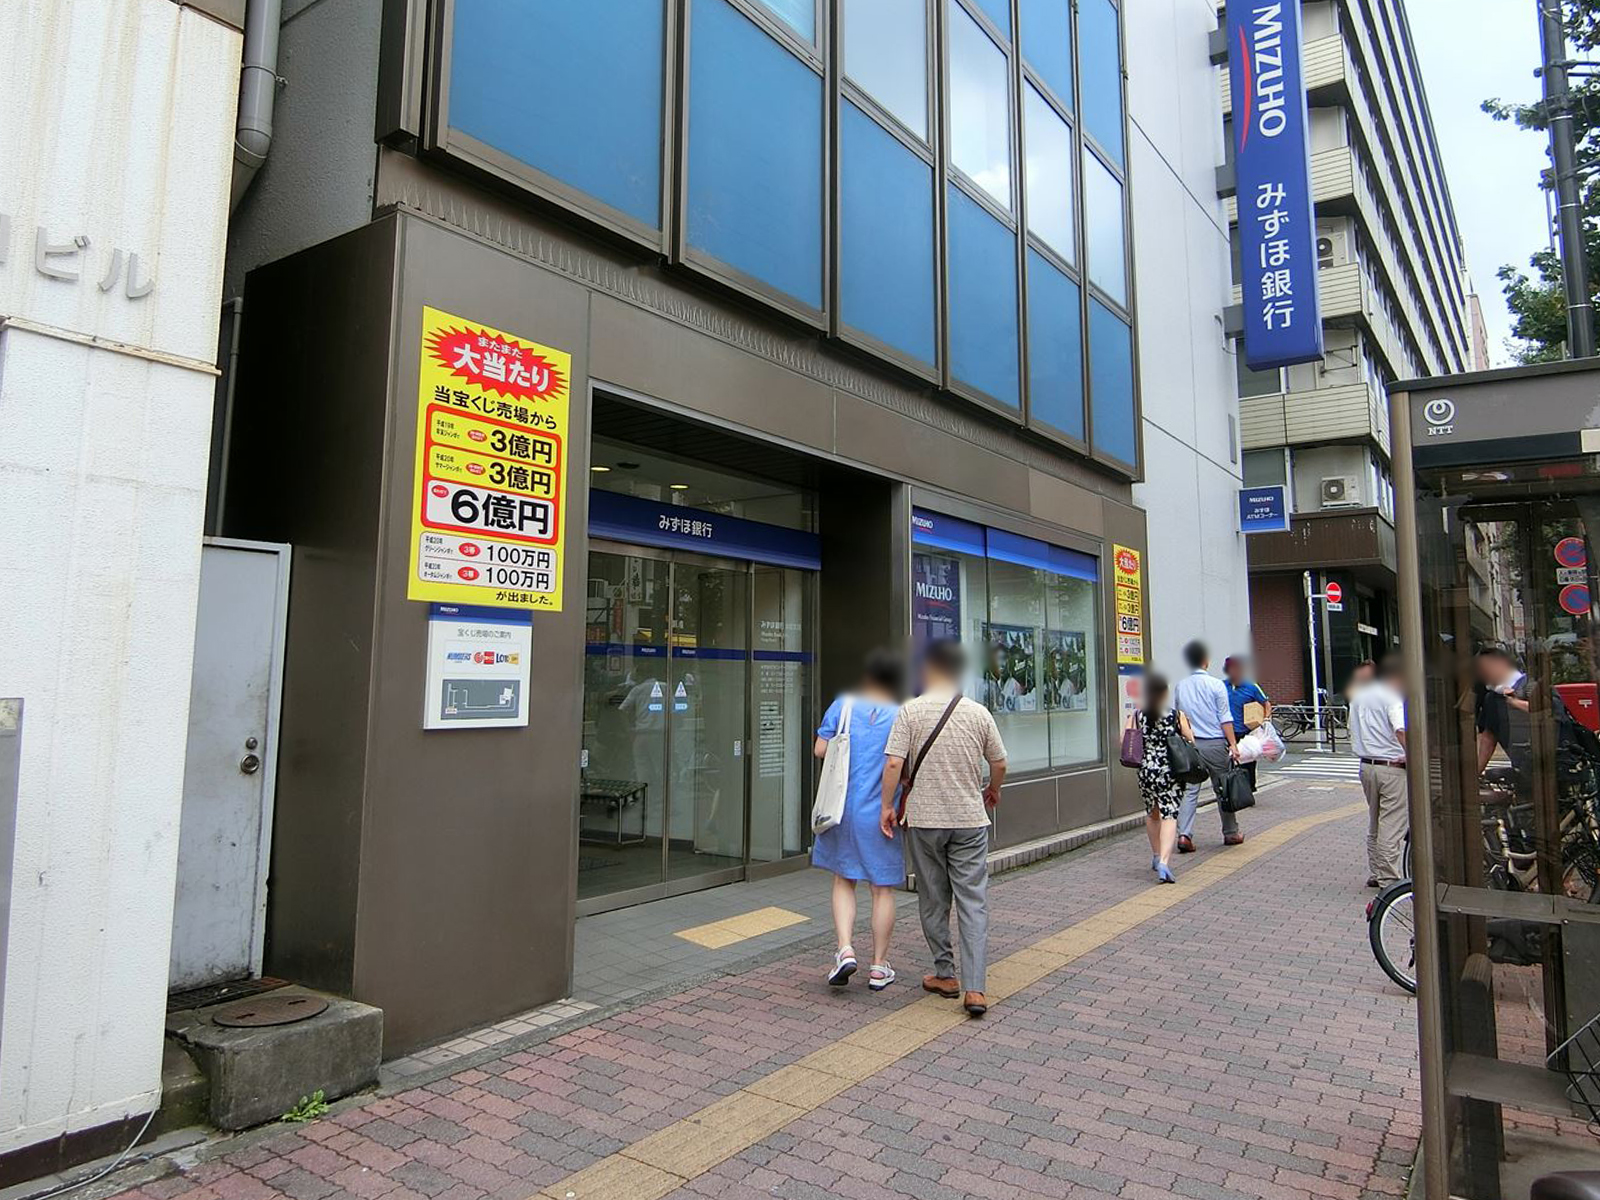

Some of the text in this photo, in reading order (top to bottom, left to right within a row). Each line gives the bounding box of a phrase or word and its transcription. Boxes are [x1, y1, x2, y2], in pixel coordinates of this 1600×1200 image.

[1252, 2, 1287, 138] MIZUHO
[1256, 181, 1294, 330] みずほ銀行
[477, 336, 523, 359] またまた
[453, 343, 549, 392] 大当たり
[434, 385, 557, 430] 当宝くじ売場から
[1427, 425, 1454, 436] NTT
[490, 429, 552, 464] 3億円
[489, 462, 551, 495] 3億円
[451, 489, 549, 535] 6億円
[658, 514, 713, 538] みずほ銀行
[487, 545, 550, 569] 100万円
[486, 567, 549, 590] 100万円
[916, 581, 952, 601] MIZUHO
[496, 591, 553, 606] が出ました。
